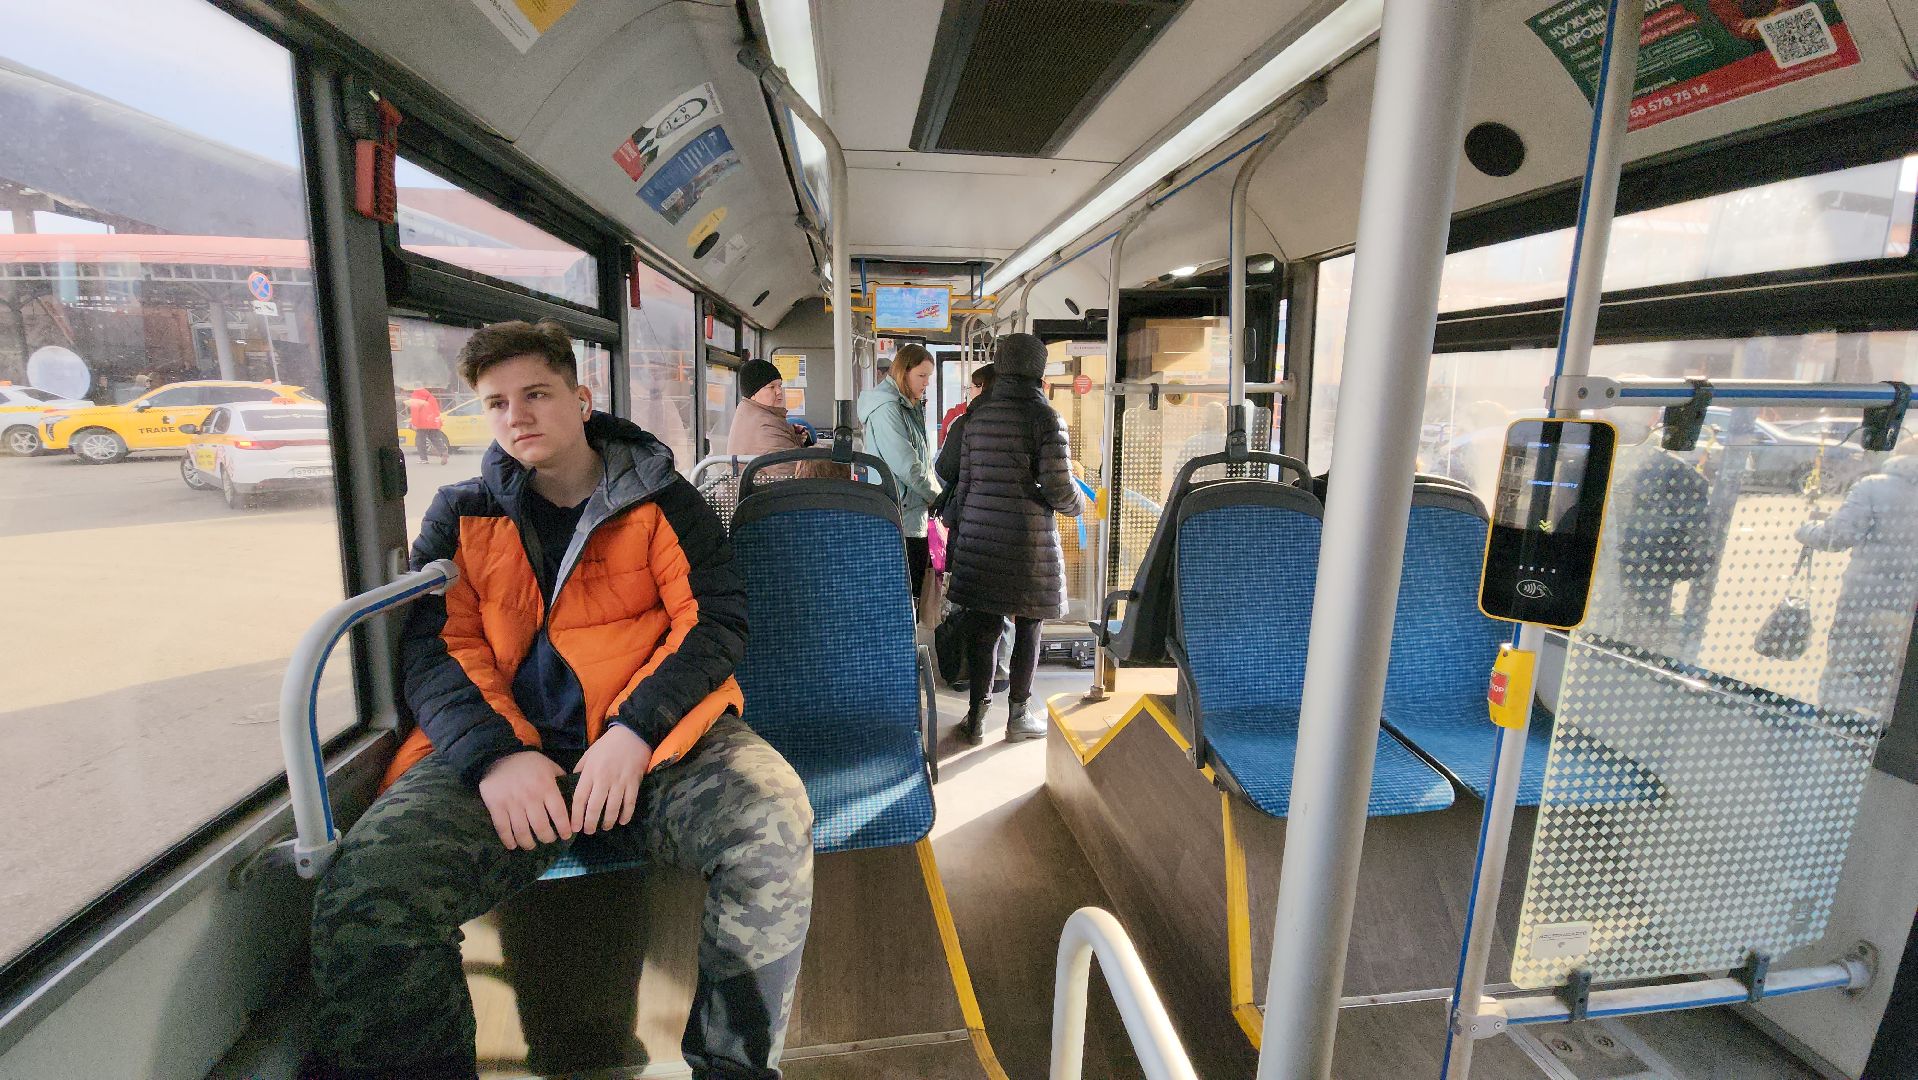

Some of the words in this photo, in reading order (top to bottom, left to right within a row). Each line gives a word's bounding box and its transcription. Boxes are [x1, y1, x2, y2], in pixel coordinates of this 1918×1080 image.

[1549, 4, 1607, 39] НУЖНЫ
[1559, 20, 1607, 49] ХОРОШ
[1648, 96, 1673, 112] 578
[1692, 83, 1708, 96] 14
[138, 426, 175, 435] TRADE
